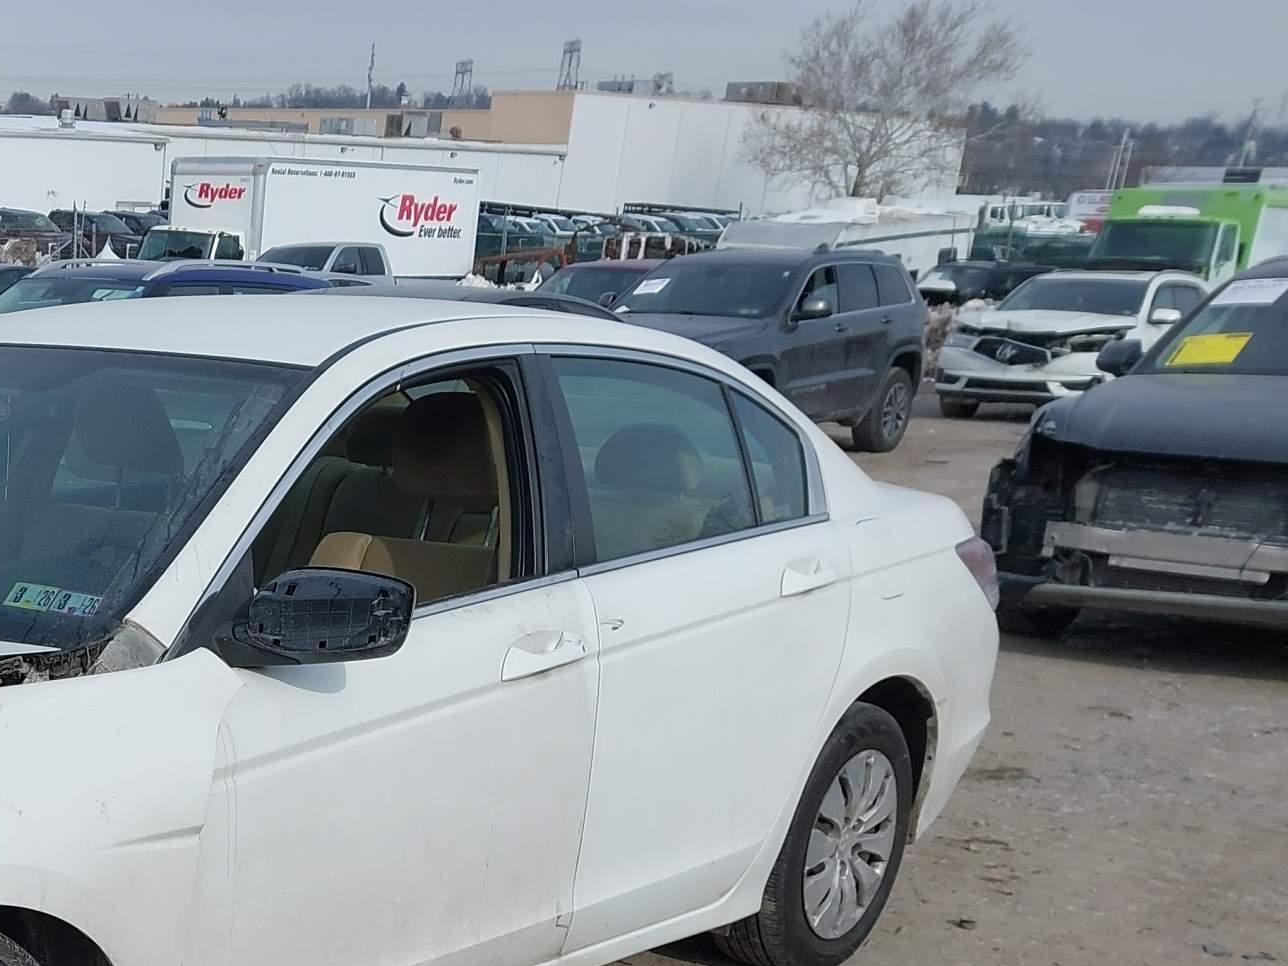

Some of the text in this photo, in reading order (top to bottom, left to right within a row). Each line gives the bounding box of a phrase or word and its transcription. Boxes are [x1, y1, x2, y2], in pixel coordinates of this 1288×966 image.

[198, 182, 246, 203] Ryder
[397, 194, 458, 228] Ryder
[418, 224, 438, 238] Ever
[13, 587, 55, 607] 3 26
[57, 593, 72, 610] 3
